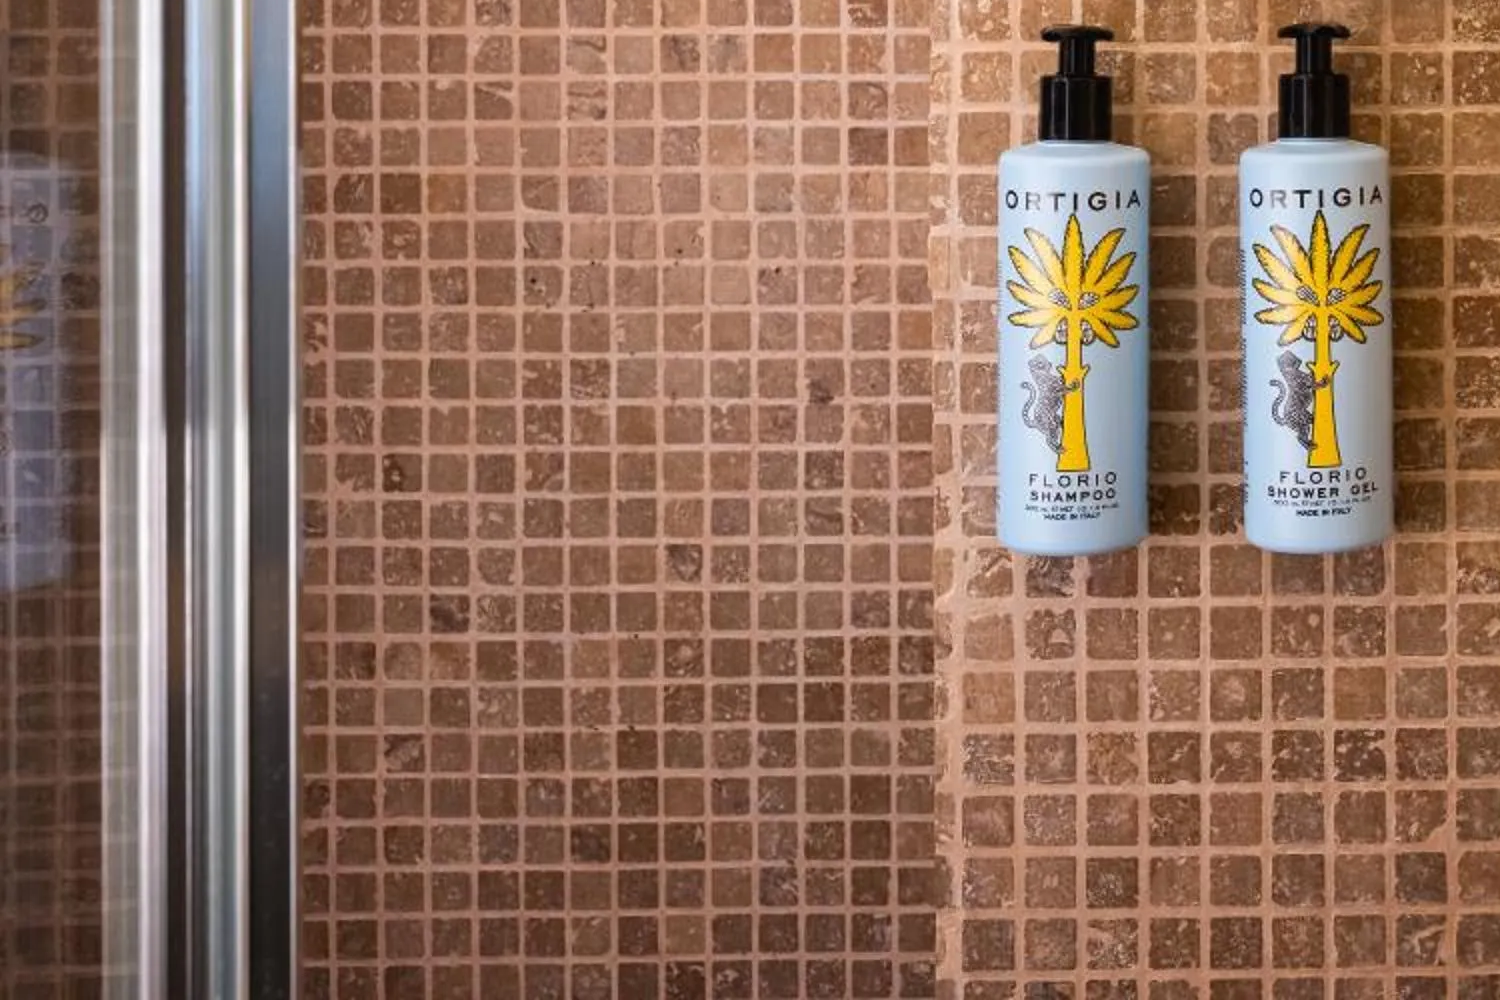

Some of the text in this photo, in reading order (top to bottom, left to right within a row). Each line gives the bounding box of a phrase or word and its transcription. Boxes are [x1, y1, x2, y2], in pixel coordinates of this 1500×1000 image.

[1005, 189, 1141, 212] ORTIGIA
[1249, 184, 1383, 209] ORTIGIA
[1029, 471, 1117, 489] FLORIO
[1279, 467, 1367, 485] FLORIO
[1030, 488, 1116, 503] SHAMPOO
[1267, 485, 1340, 499] SHOWER
